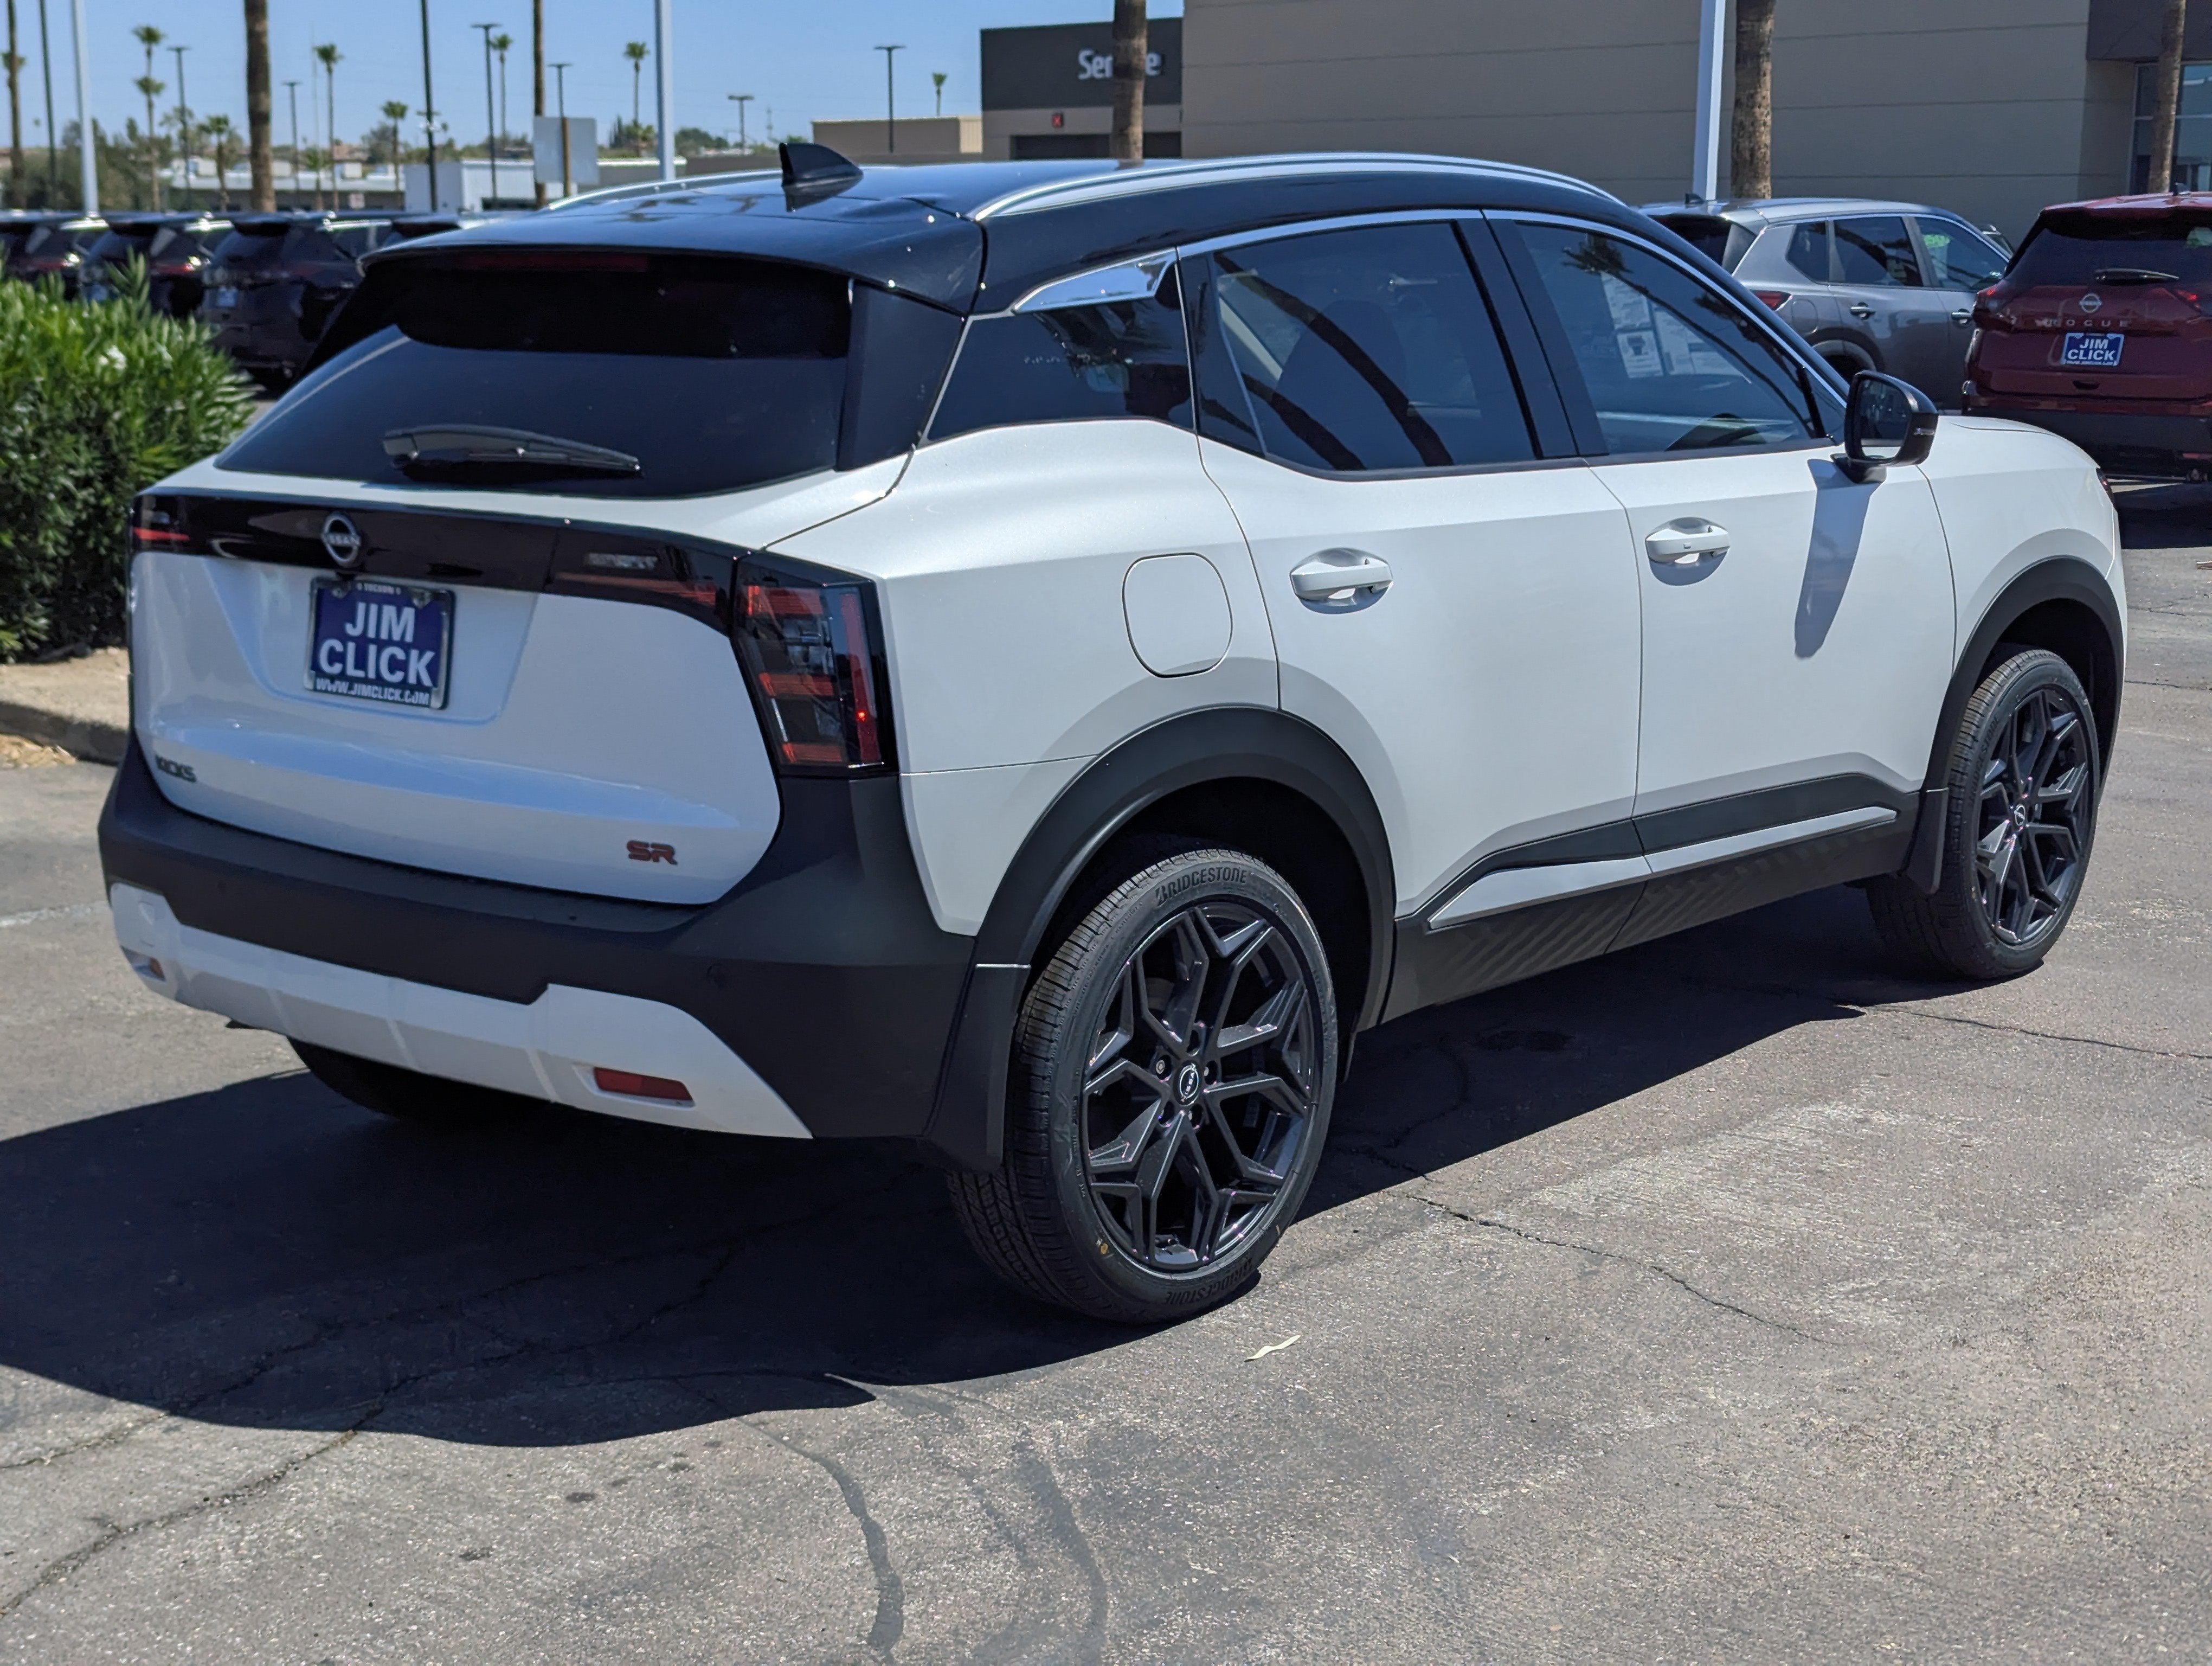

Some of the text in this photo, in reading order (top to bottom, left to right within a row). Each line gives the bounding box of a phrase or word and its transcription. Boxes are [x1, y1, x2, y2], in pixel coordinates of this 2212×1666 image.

[1078, 49, 1161, 80] Sere
[2067, 349, 2116, 361] CLICK
[2079, 338, 2108, 349] JIM
[345, 601, 416, 643] JIM
[319, 638, 435, 687] CLICK
[316, 678, 430, 705] WWW.JIMCLICK.COM
[626, 840, 678, 866] SR
[1155, 866, 1248, 907] BRIDGESTONE
